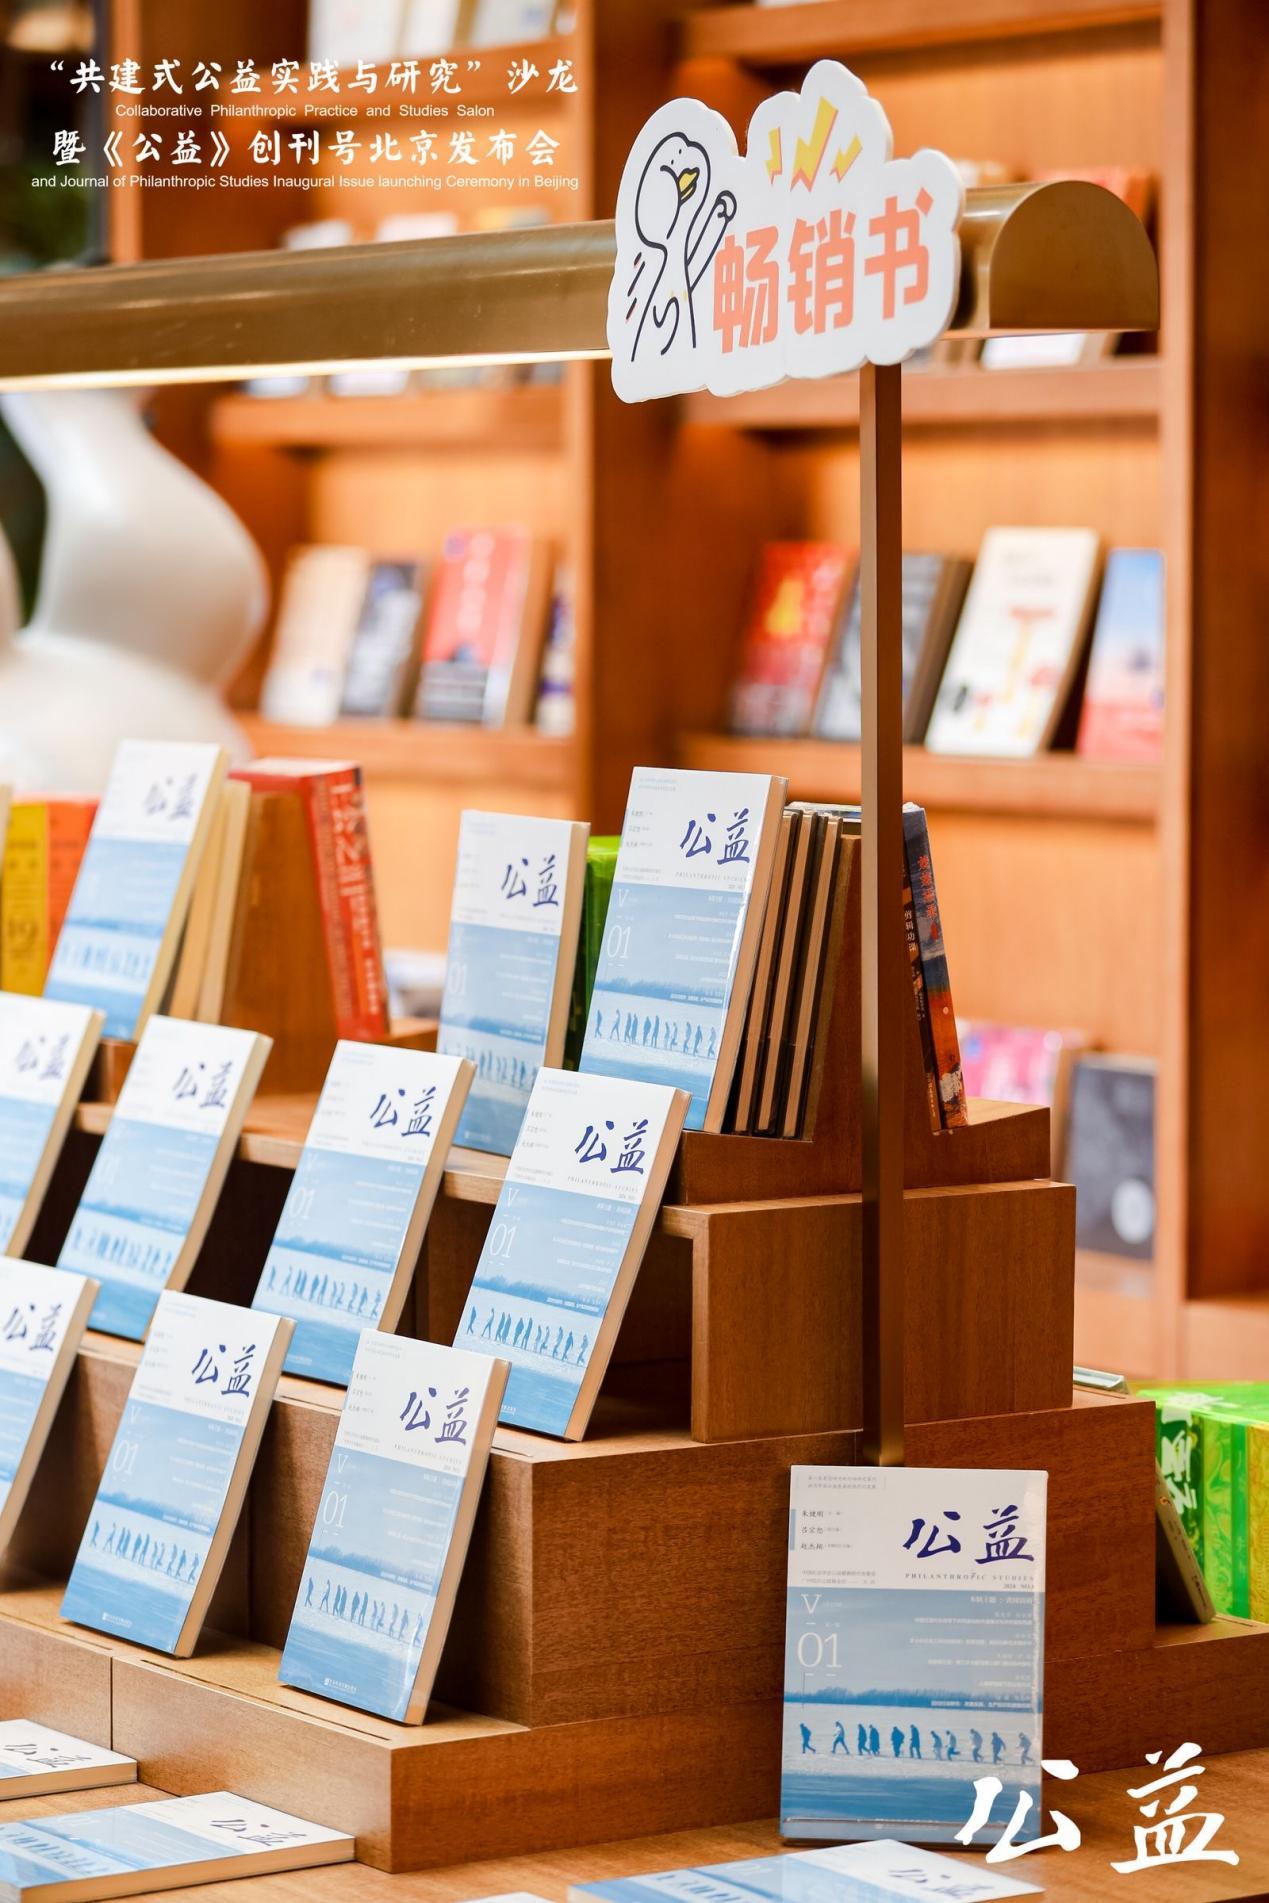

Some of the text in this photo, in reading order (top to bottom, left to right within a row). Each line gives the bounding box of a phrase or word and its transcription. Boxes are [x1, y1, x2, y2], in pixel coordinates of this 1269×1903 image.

[712, 187, 934, 354] 畅销书
[680, 808, 750, 865] 公益
[501, 854, 560, 907] 公益
[605, 924, 631, 960] 01
[369, 1086, 438, 1137] 公益
[574, 1118, 649, 1175] 公益
[487, 1222, 517, 1259] 01
[2, 1303, 63, 1352] 公益
[191, 1343, 257, 1398] 公益
[399, 1386, 470, 1446] 公益
[111, 1439, 141, 1477] 01
[321, 1490, 350, 1529] 01
[902, 1504, 1035, 1565] 公益
[800, 1593, 823, 1614] V
[797, 1632, 843, 1668] 01
